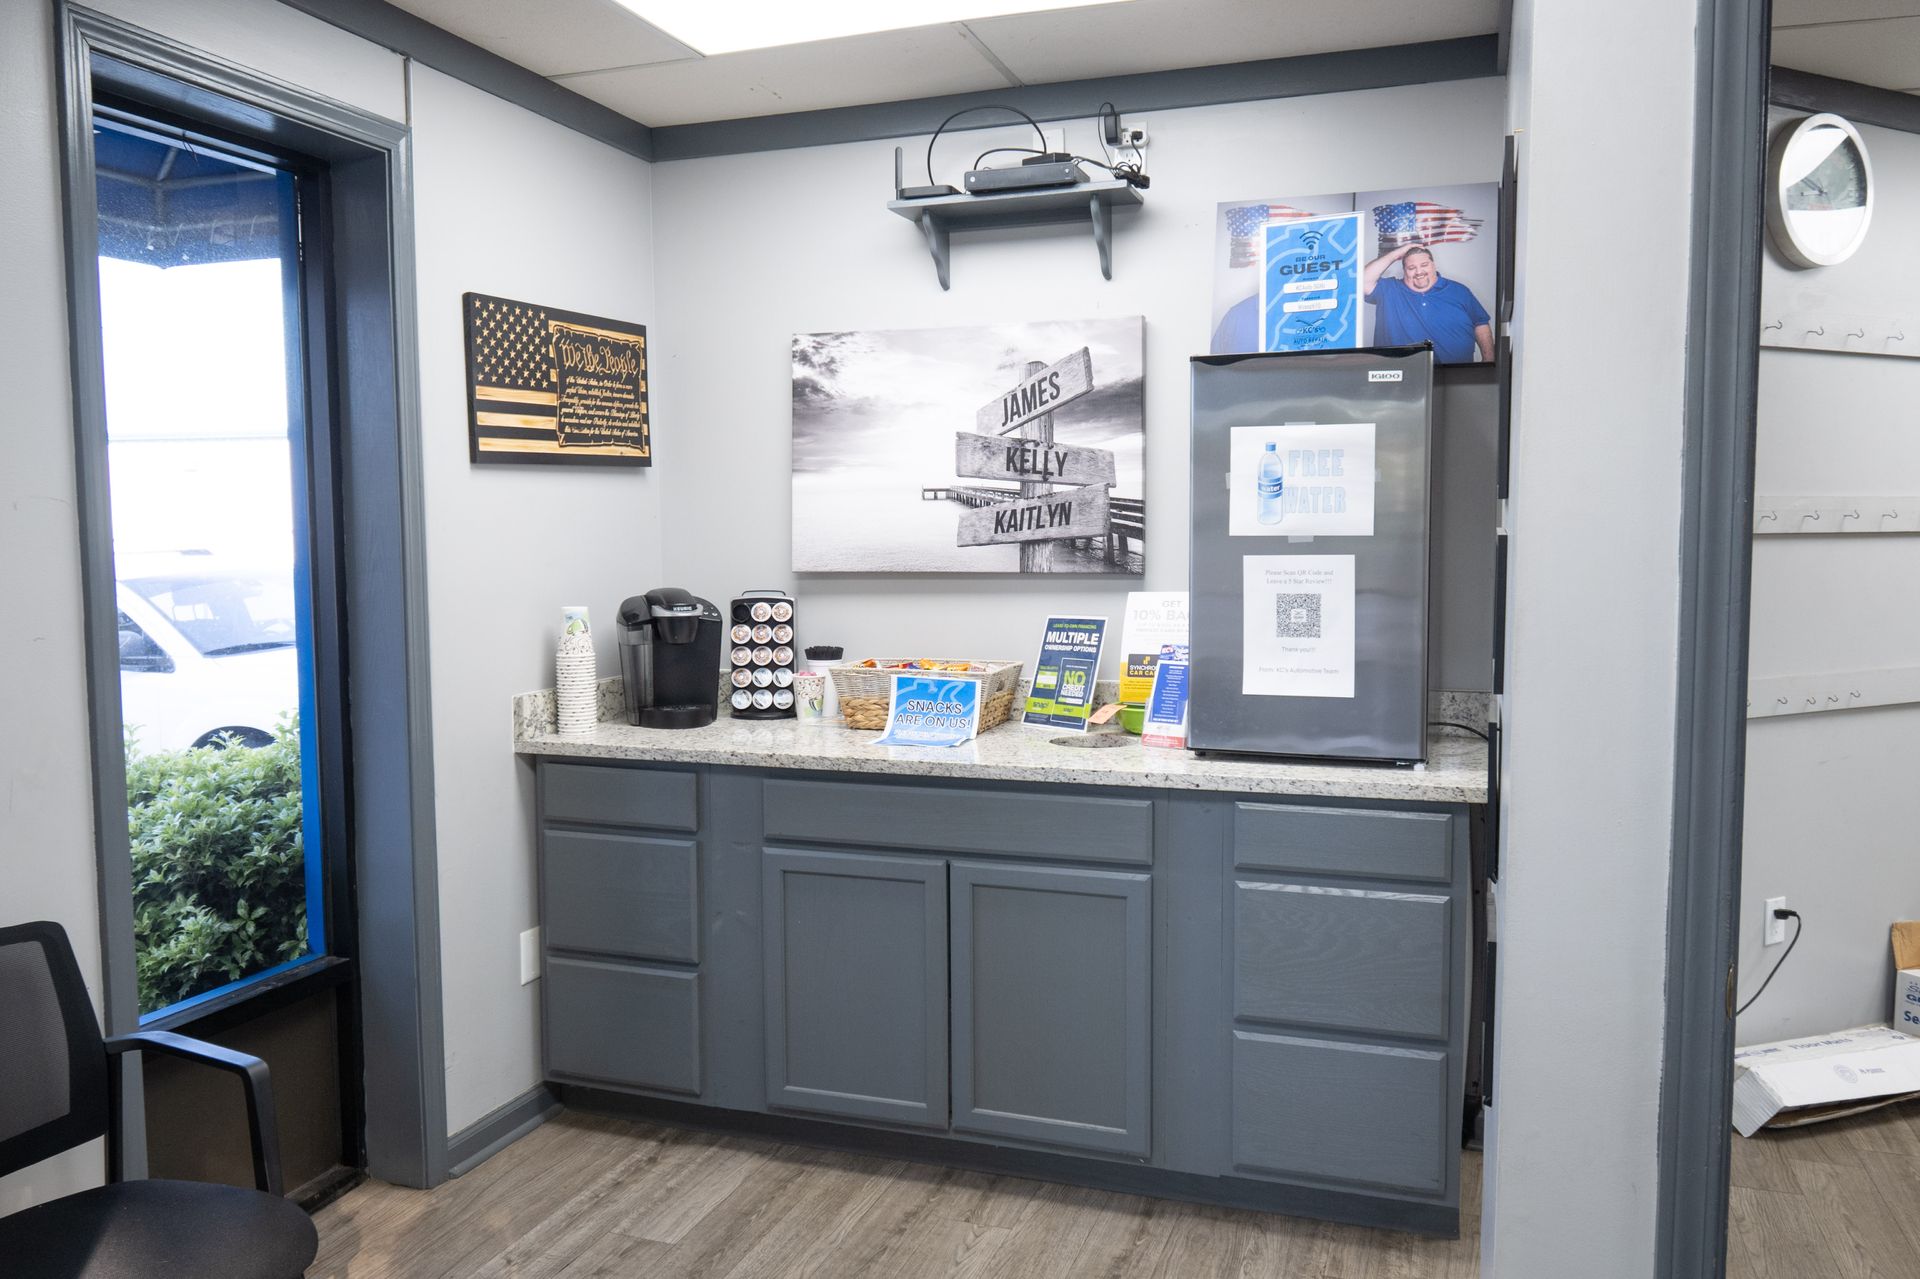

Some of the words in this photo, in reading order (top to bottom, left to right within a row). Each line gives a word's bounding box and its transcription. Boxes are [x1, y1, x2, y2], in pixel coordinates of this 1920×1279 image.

[1279, 259, 1343, 276] GUEST
[559, 338, 584, 371] We
[599, 346, 639, 383] People
[1002, 371, 1060, 427] JAMES
[1006, 446, 1068, 477] KELLY
[1288, 449, 1345, 477] FREE
[1284, 486, 1346, 513] WATER
[994, 502, 1072, 534] KAITLYN
[1162, 600, 1184, 608] GET
[1133, 609, 1161, 621] 10%
[1166, 609, 1188, 621] BA
[1046, 631, 1100, 645] MULTIPLE
[1044, 644, 1073, 652] OWNERSHIP
[1073, 645, 1097, 653] OPTIONS
[1064, 670, 1086, 686] NO
[1060, 690, 1084, 698] NEEDED
[1062, 684, 1085, 693] CREDIT
[907, 700, 962, 715] SNACKS
[895, 714, 921, 726] ARE
[925, 716, 946, 728] ON
[949, 718, 971, 729] US!
